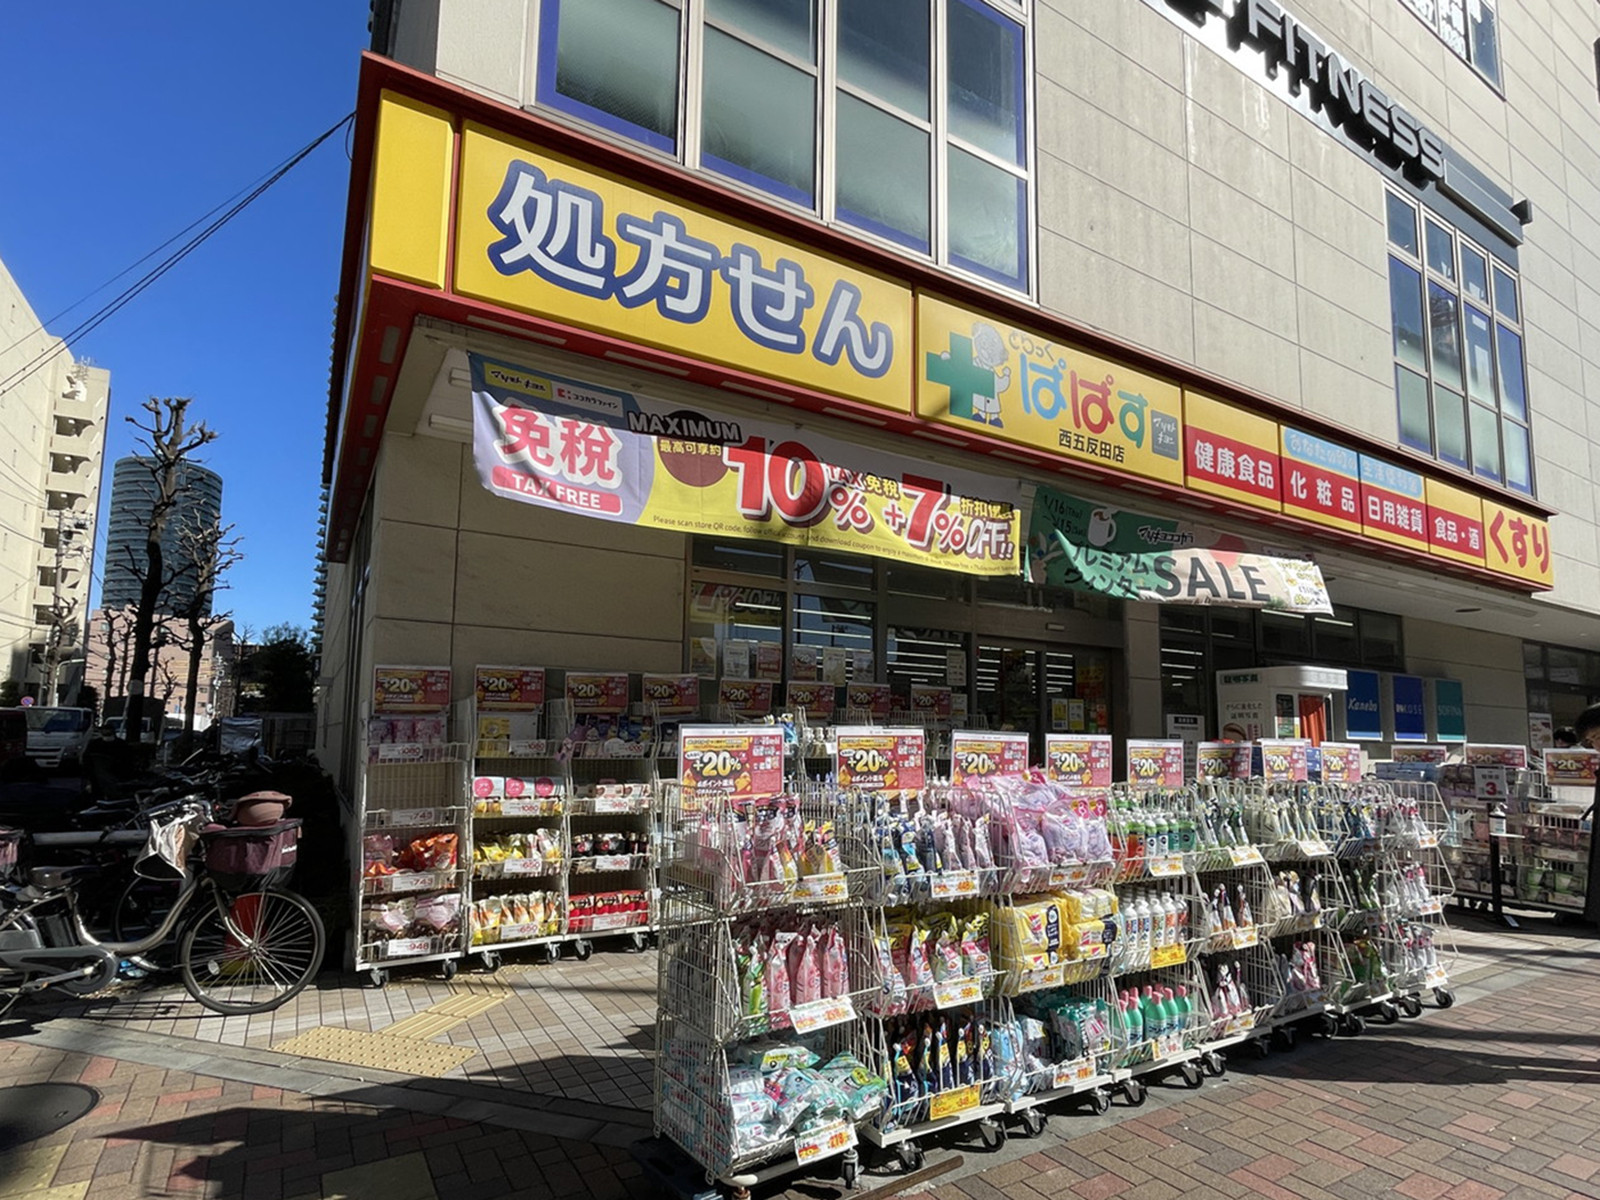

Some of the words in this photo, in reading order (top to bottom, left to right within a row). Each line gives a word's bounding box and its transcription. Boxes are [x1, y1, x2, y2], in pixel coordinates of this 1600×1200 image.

[1249, 0, 1446, 180] FITNESS
[487, 159, 893, 378] 処方せん
[1019, 352, 1149, 449] ぱぱす
[627, 411, 744, 444] MAXIMUM
[1058, 428, 1126, 464] 西五反田店
[826, 463, 862, 489] TAX
[1193, 438, 1275, 491] 健康食品
[511, 473, 551, 498] TAX
[556, 484, 602, 509] FREE
[1290, 470, 1356, 514] 化粧品
[653, 515, 675, 525] Please
[677, 519, 693, 527] scan
[694, 520, 712, 529] store
[713, 522, 724, 531] QR
[1367, 494, 1424, 535] 日用雑貨
[1434, 516, 1481, 552] 食品・酒
[1489, 509, 1550, 575] くすり
[1154, 555, 1271, 602] SALE
[1348, 697, 1378, 713] Kanebo
